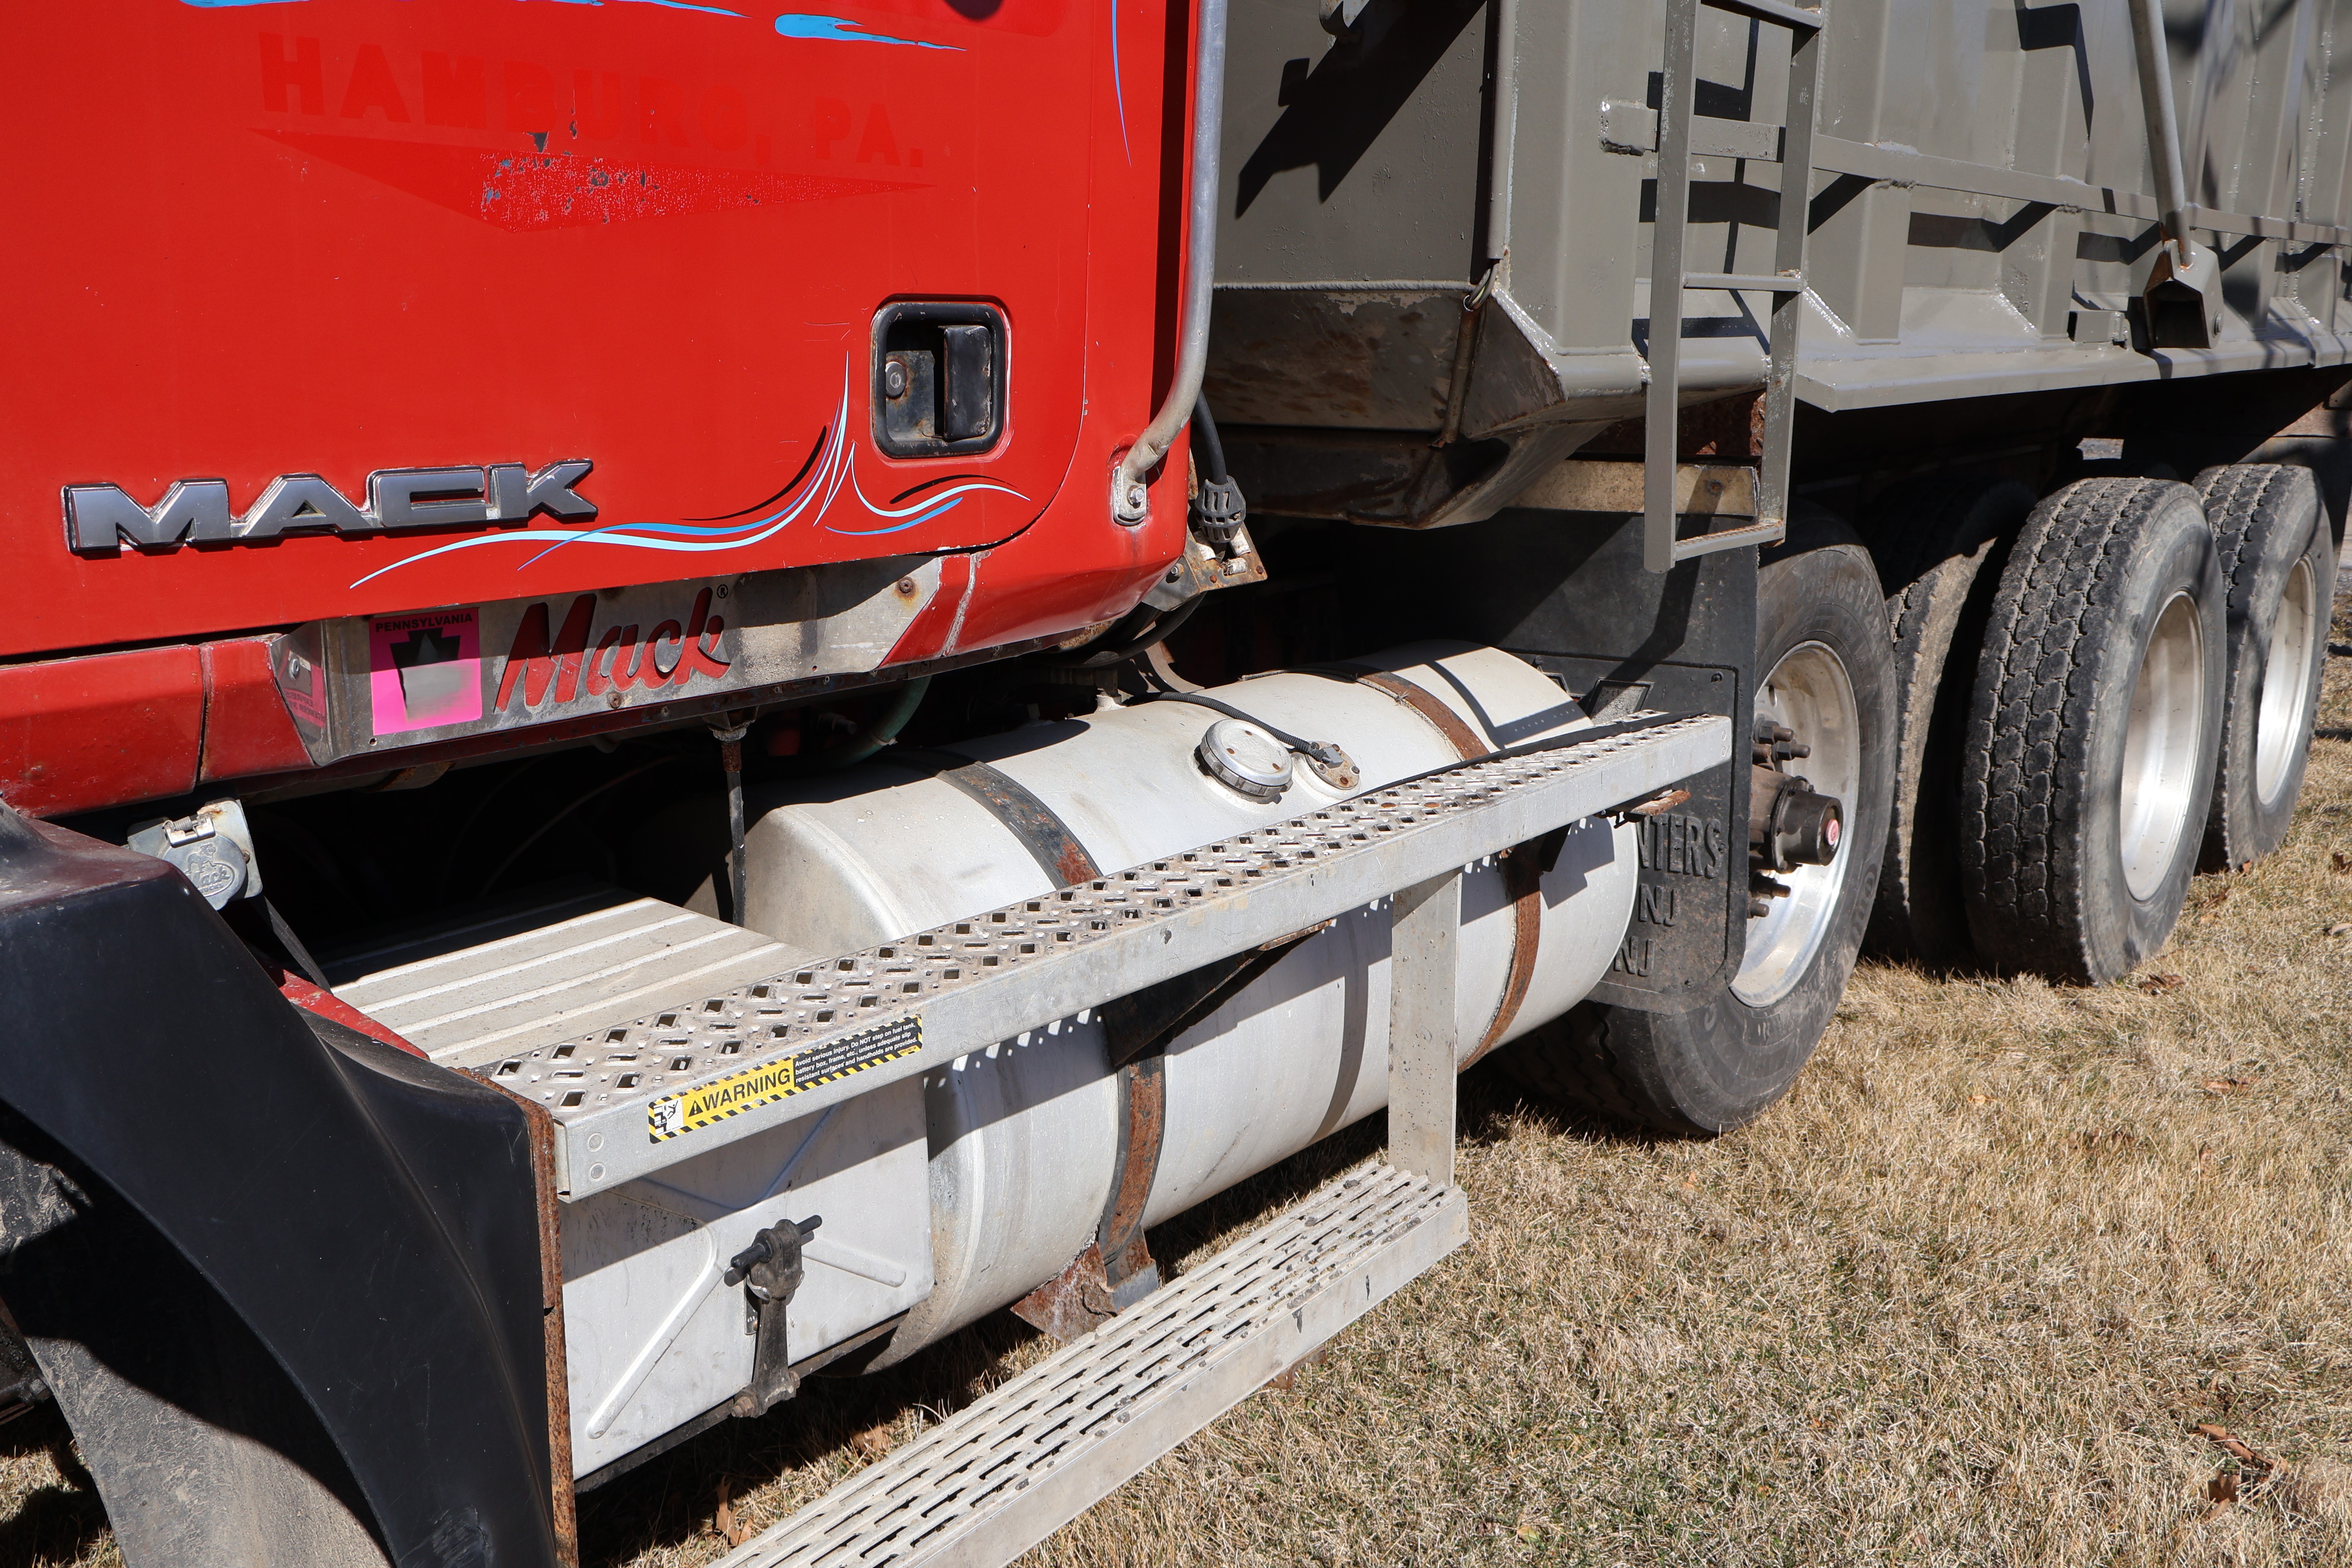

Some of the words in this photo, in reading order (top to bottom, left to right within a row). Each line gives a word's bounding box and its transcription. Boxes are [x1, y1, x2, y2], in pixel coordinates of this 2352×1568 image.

[812, 95, 924, 169] PA.
[63, 459, 597, 553] MACK
[376, 613, 473, 633] PENNSYLVANIA
[1639, 884, 1681, 927] NJ
[795, 1057, 811, 1067] Avoid
[812, 1051, 832, 1061] serious
[833, 1045, 850, 1054] injury.
[860, 1036, 871, 1045] NOT
[872, 1033, 884, 1042] step
[892, 1026, 902, 1034] fuel
[903, 1022, 916, 1032] tank,
[795, 1064, 815, 1075] battery
[829, 1054, 846, 1064] frame,
[859, 1044, 878, 1054] unless
[877, 1035, 901, 1047] adequate
[796, 1071, 820, 1083] resistant
[821, 1063, 844, 1074] surfaces
[846, 1058, 855, 1066] and
[857, 1049, 884, 1061] handholds
[894, 1037, 918, 1049] provided.
[702, 1068, 791, 1111] WARNING
